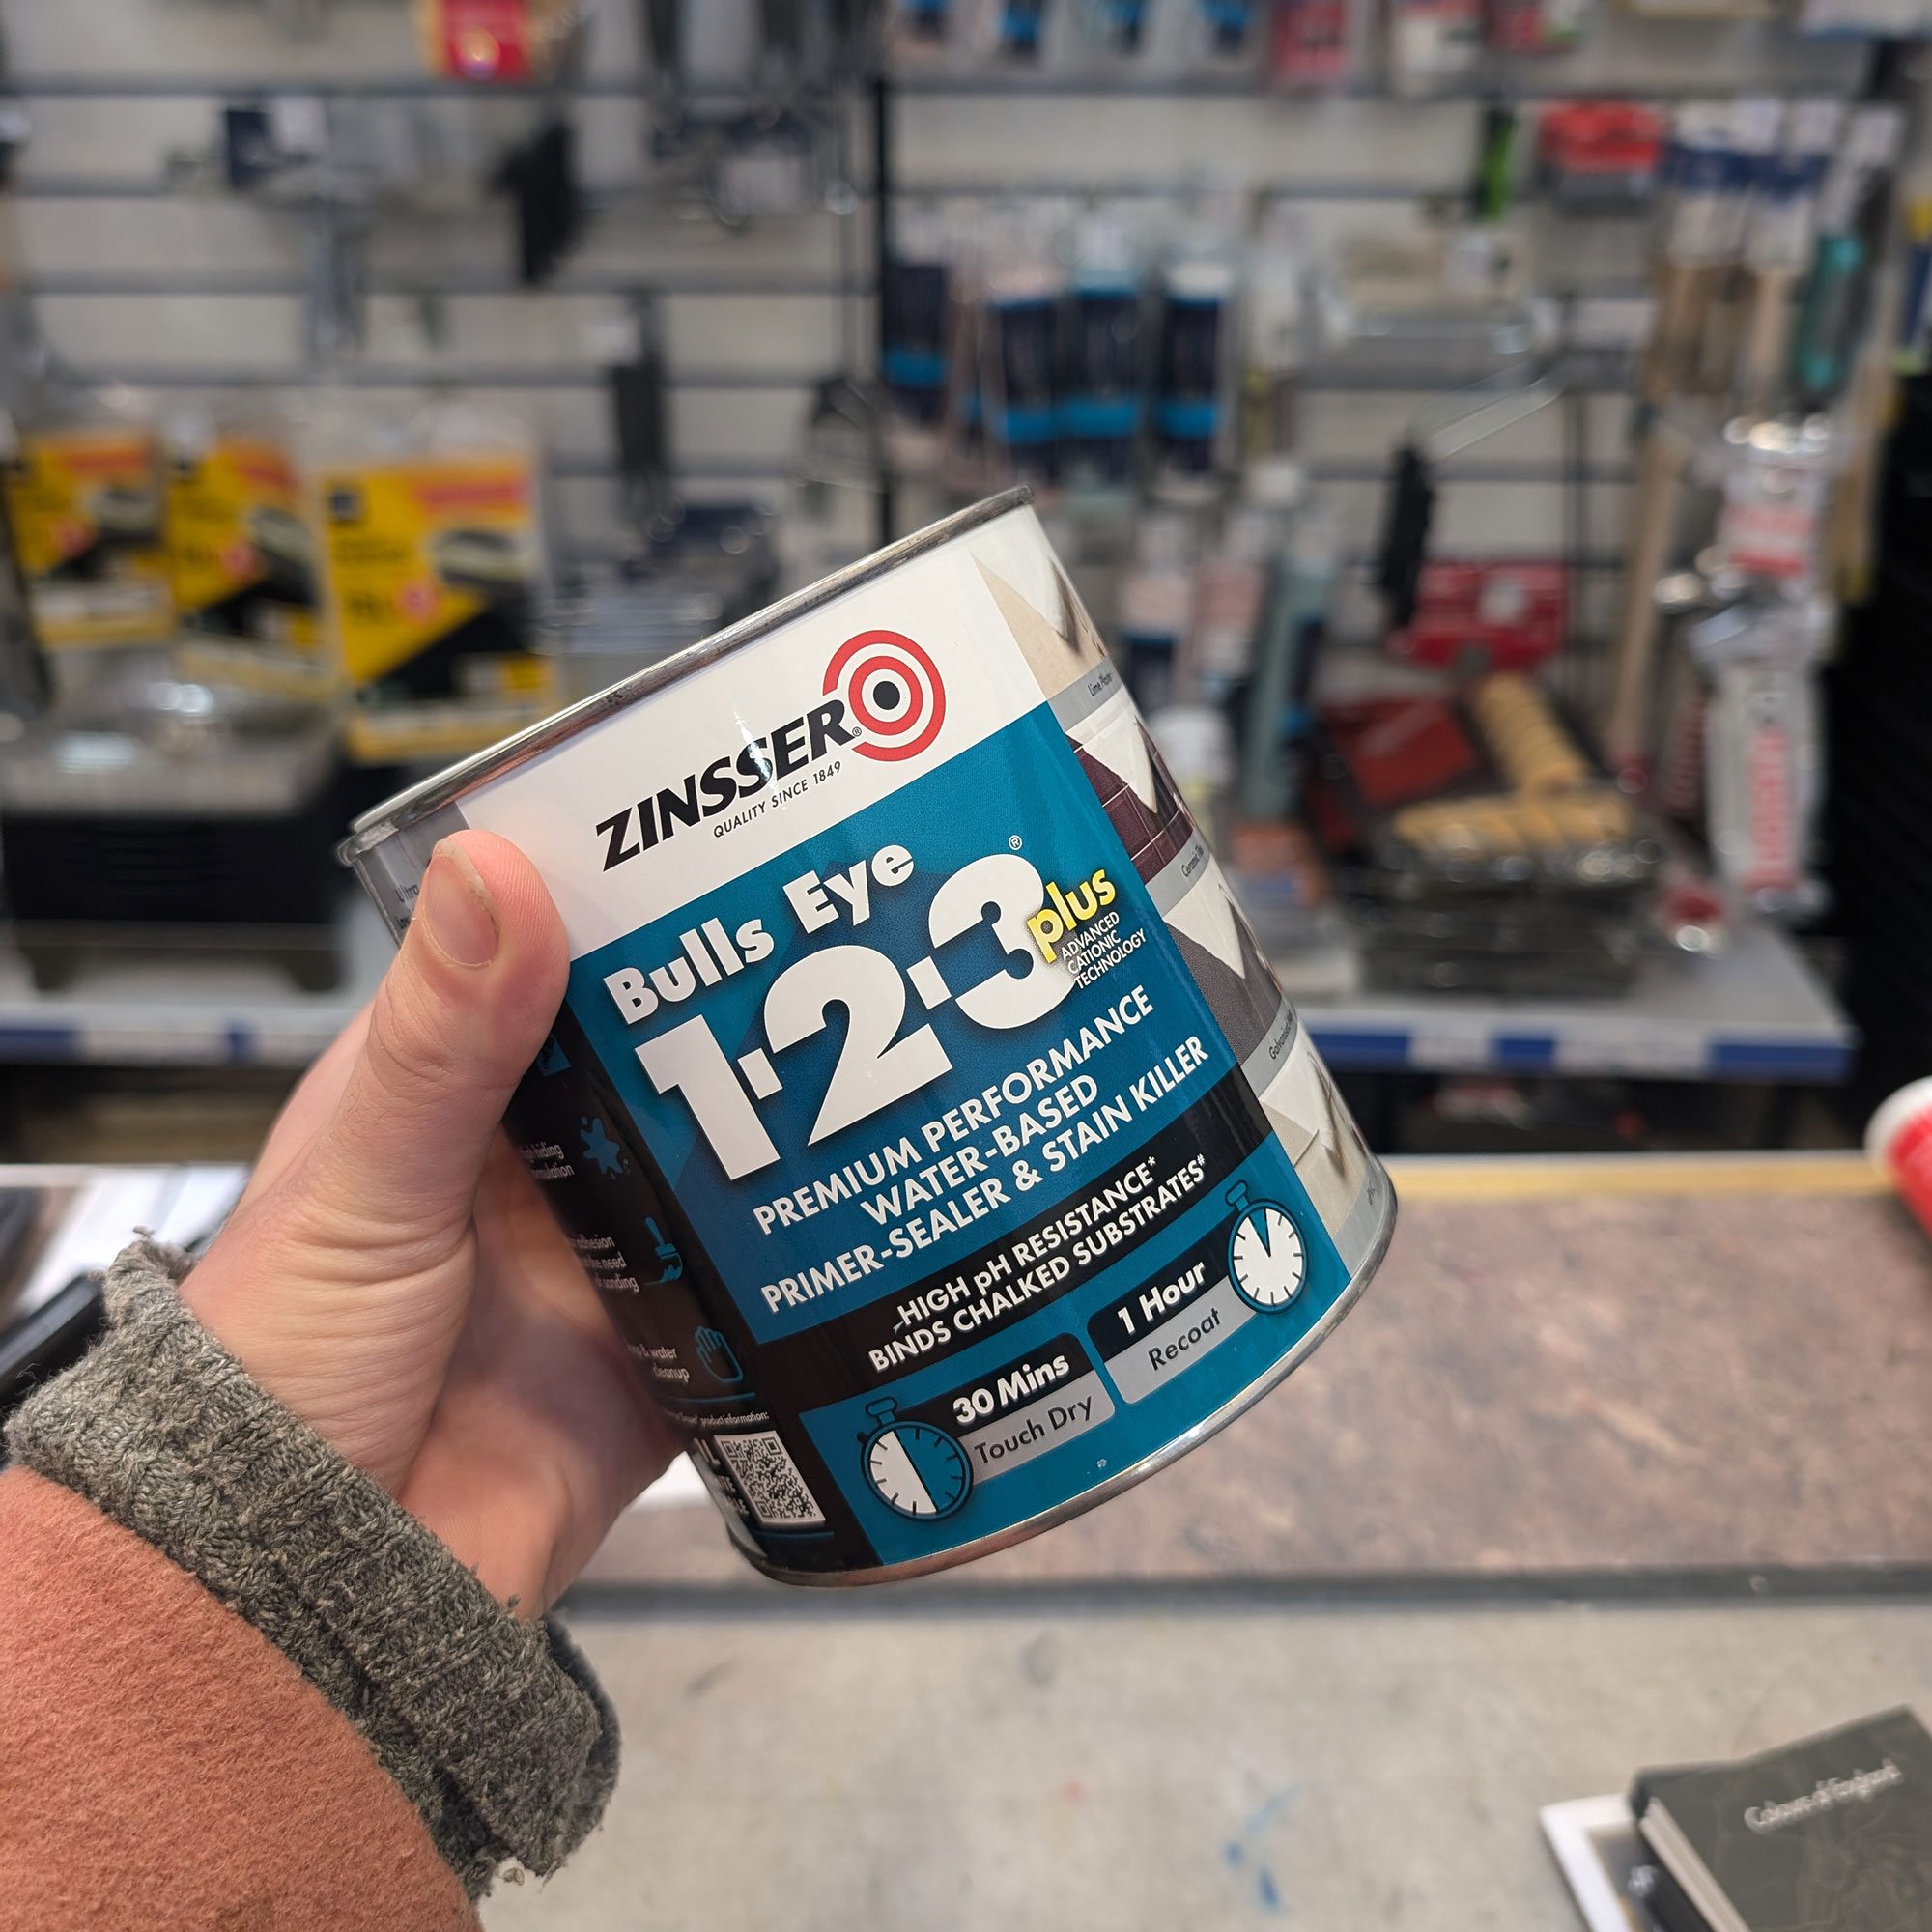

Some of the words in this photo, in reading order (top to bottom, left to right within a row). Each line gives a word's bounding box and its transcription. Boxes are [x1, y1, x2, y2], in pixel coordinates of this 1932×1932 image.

[713, 800, 766, 838] QUALITY
[771, 778, 809, 808] SINCE
[812, 760, 841, 785] 1849
[395, 884, 420, 903] Ultra
[1027, 869, 1116, 964] plus
[603, 917, 775, 1025] Bulls
[782, 844, 914, 934] Eye
[1061, 911, 1120, 962] ADVANCED
[1067, 929, 1122, 975] CATIONIC
[1074, 928, 1147, 990] TECHNOLOGY
[753, 1137, 923, 1236] PREMIUM
[921, 984, 1154, 1153] PERFORMANCE
[760, 1178, 1011, 1314] PRIMER-SEALER
[1014, 1160, 1044, 1192] &
[1049, 1100, 1133, 1174] STAIN
[1128, 1035, 1209, 1113] KILLER
[860, 1074, 1099, 1226] WATER-BASED
[602, 1252, 627, 1269] need
[896, 1276, 971, 1327] HIGH
[974, 1254, 1014, 1297] pH
[868, 1320, 952, 1374] BINDS
[953, 1256, 1070, 1332] CHALKED
[1117, 1305, 1136, 1336] 1
[1138, 1260, 1207, 1323] Hour
[649, 1345, 678, 1359] water
[1148, 1307, 1221, 1372] Recoat
[952, 1387, 996, 1426] 30
[996, 1353, 1070, 1409] Mins
[974, 1418, 1045, 1463] Touch
[1048, 1396, 1094, 1430] Dry
